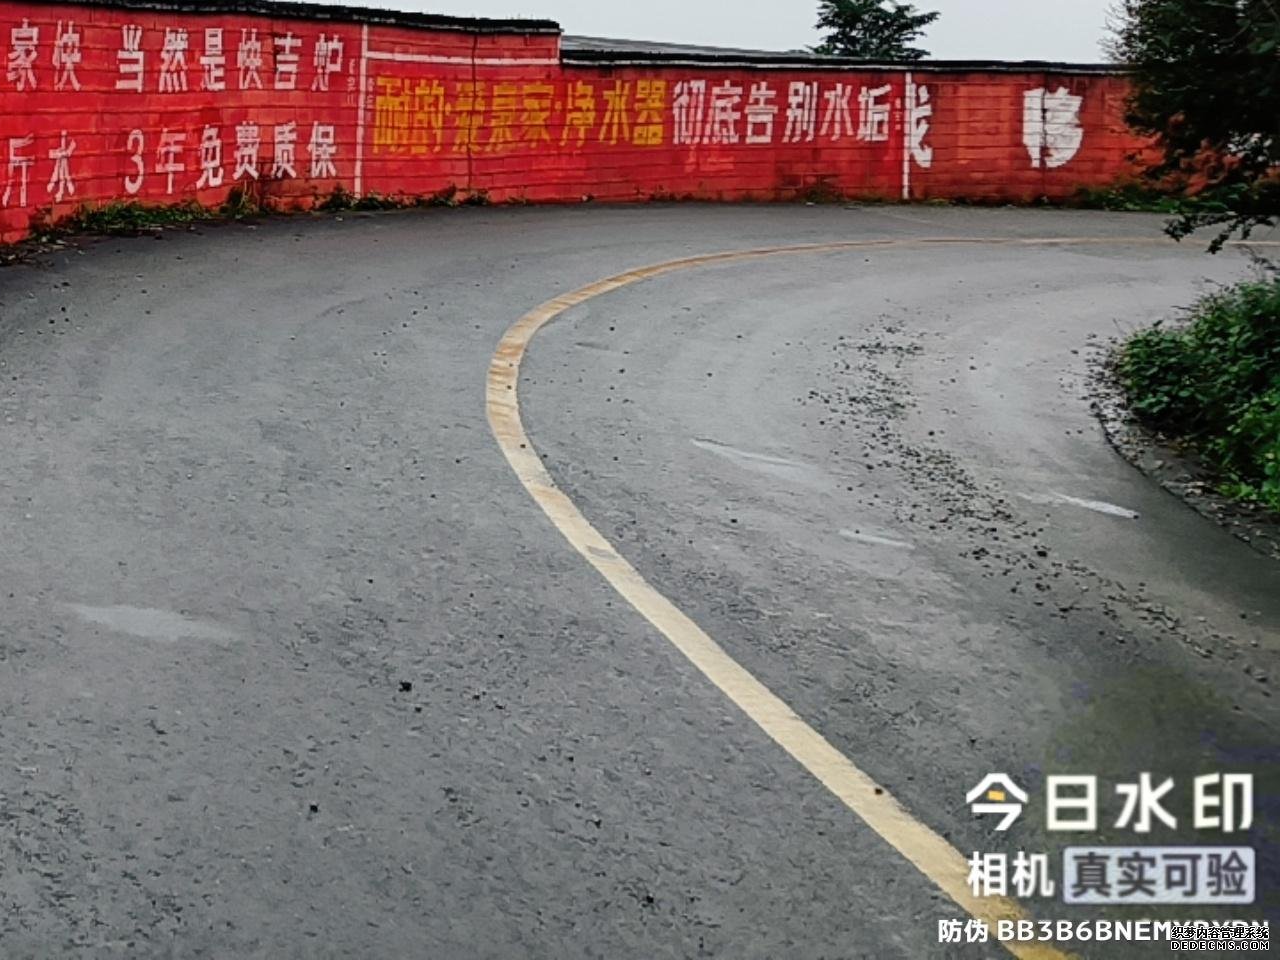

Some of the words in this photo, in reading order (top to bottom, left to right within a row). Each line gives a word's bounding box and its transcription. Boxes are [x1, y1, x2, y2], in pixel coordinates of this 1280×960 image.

[116, 24, 344, 93] 当然是快吉炉
[672, 80, 892, 145] 彻底告别水垢
[125, 121, 336, 194] 3年免费质保
